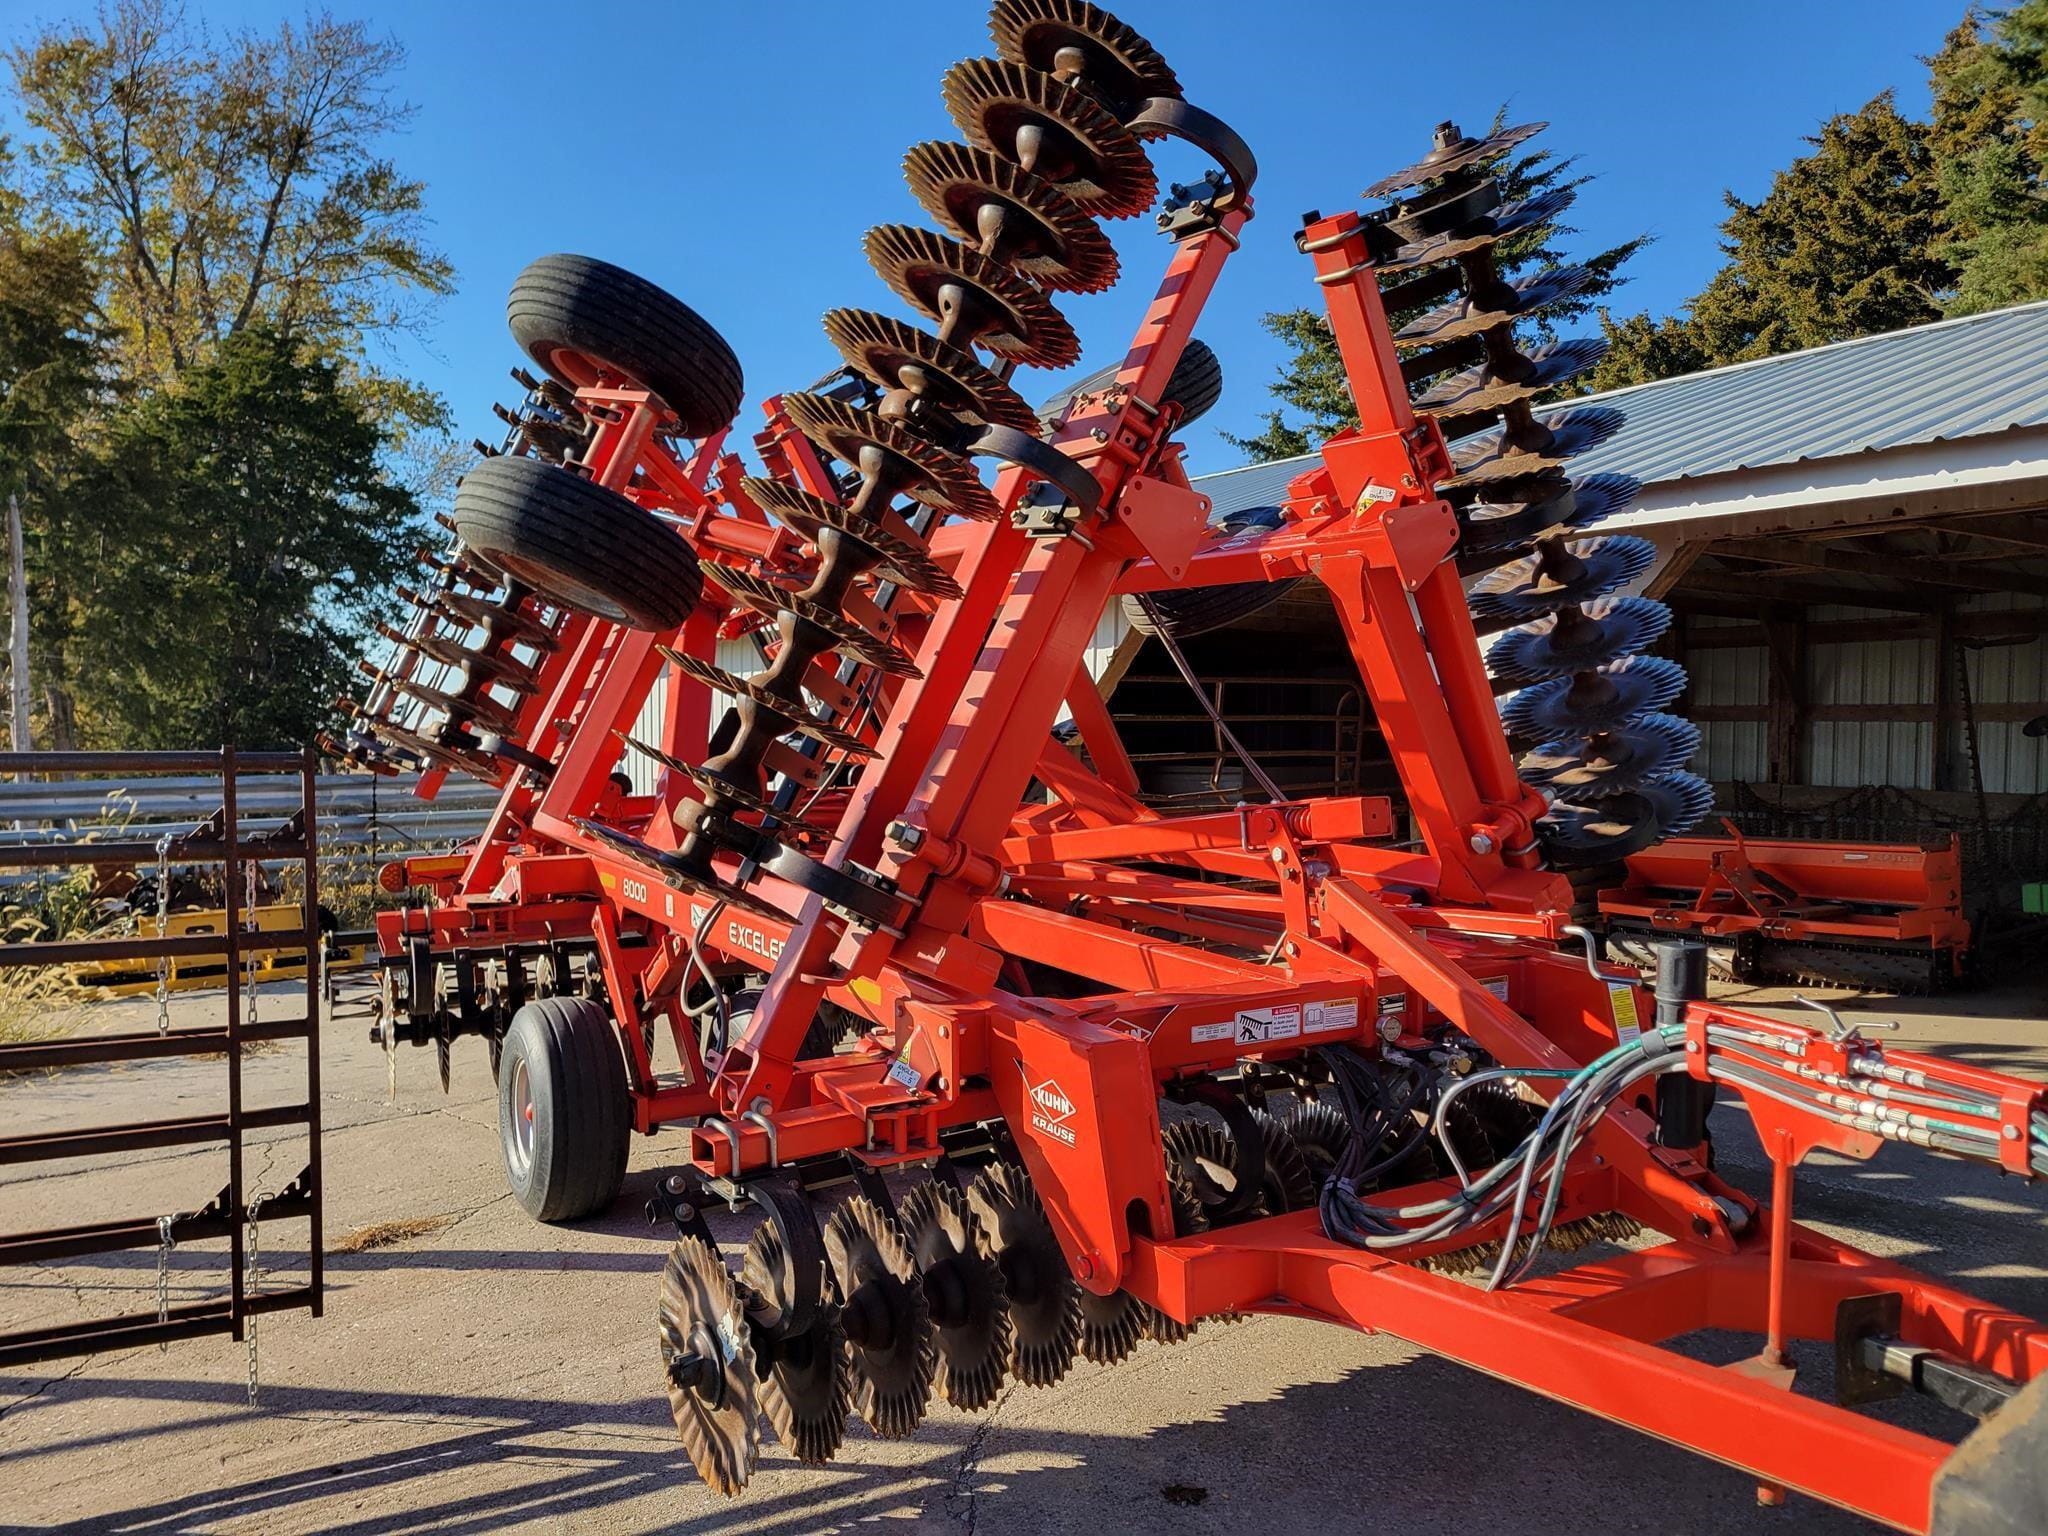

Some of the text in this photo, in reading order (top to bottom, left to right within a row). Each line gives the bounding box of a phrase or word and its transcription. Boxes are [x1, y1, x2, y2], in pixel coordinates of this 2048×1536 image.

[623, 878, 647, 904] 8000
[1037, 1087, 1070, 1115] KUHN
[1032, 1115, 1075, 1144] KRAUSE
